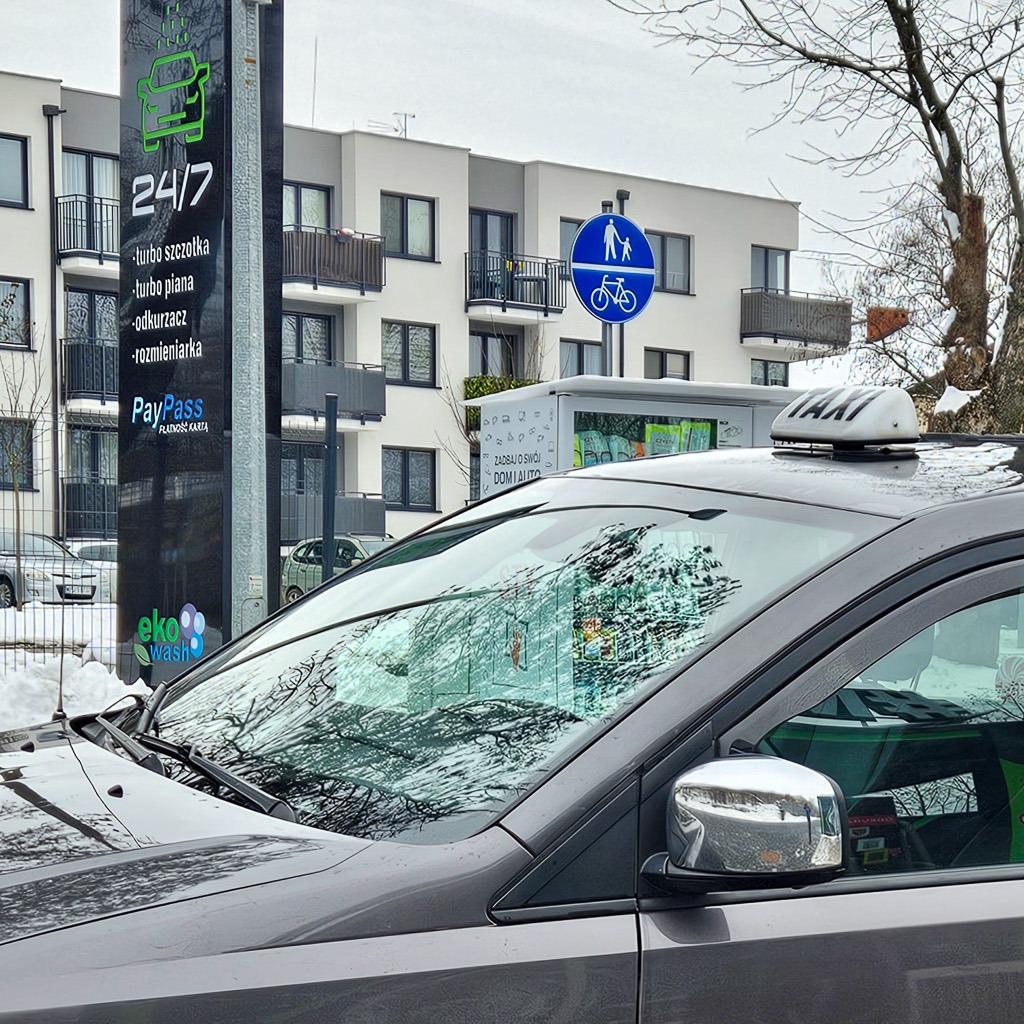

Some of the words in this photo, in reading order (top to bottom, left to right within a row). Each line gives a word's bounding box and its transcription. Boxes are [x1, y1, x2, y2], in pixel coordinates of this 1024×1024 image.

[132, 161, 213, 217] 24/7
[164, 235, 210, 262] szczotka
[165, 272, 195, 300] piana
[132, 393, 204, 429] PayPass
[787, 387, 887, 421] TAXI
[494, 471, 513, 485] DOM
[138, 608, 180, 643] eko
[150, 640, 190, 662] wash
